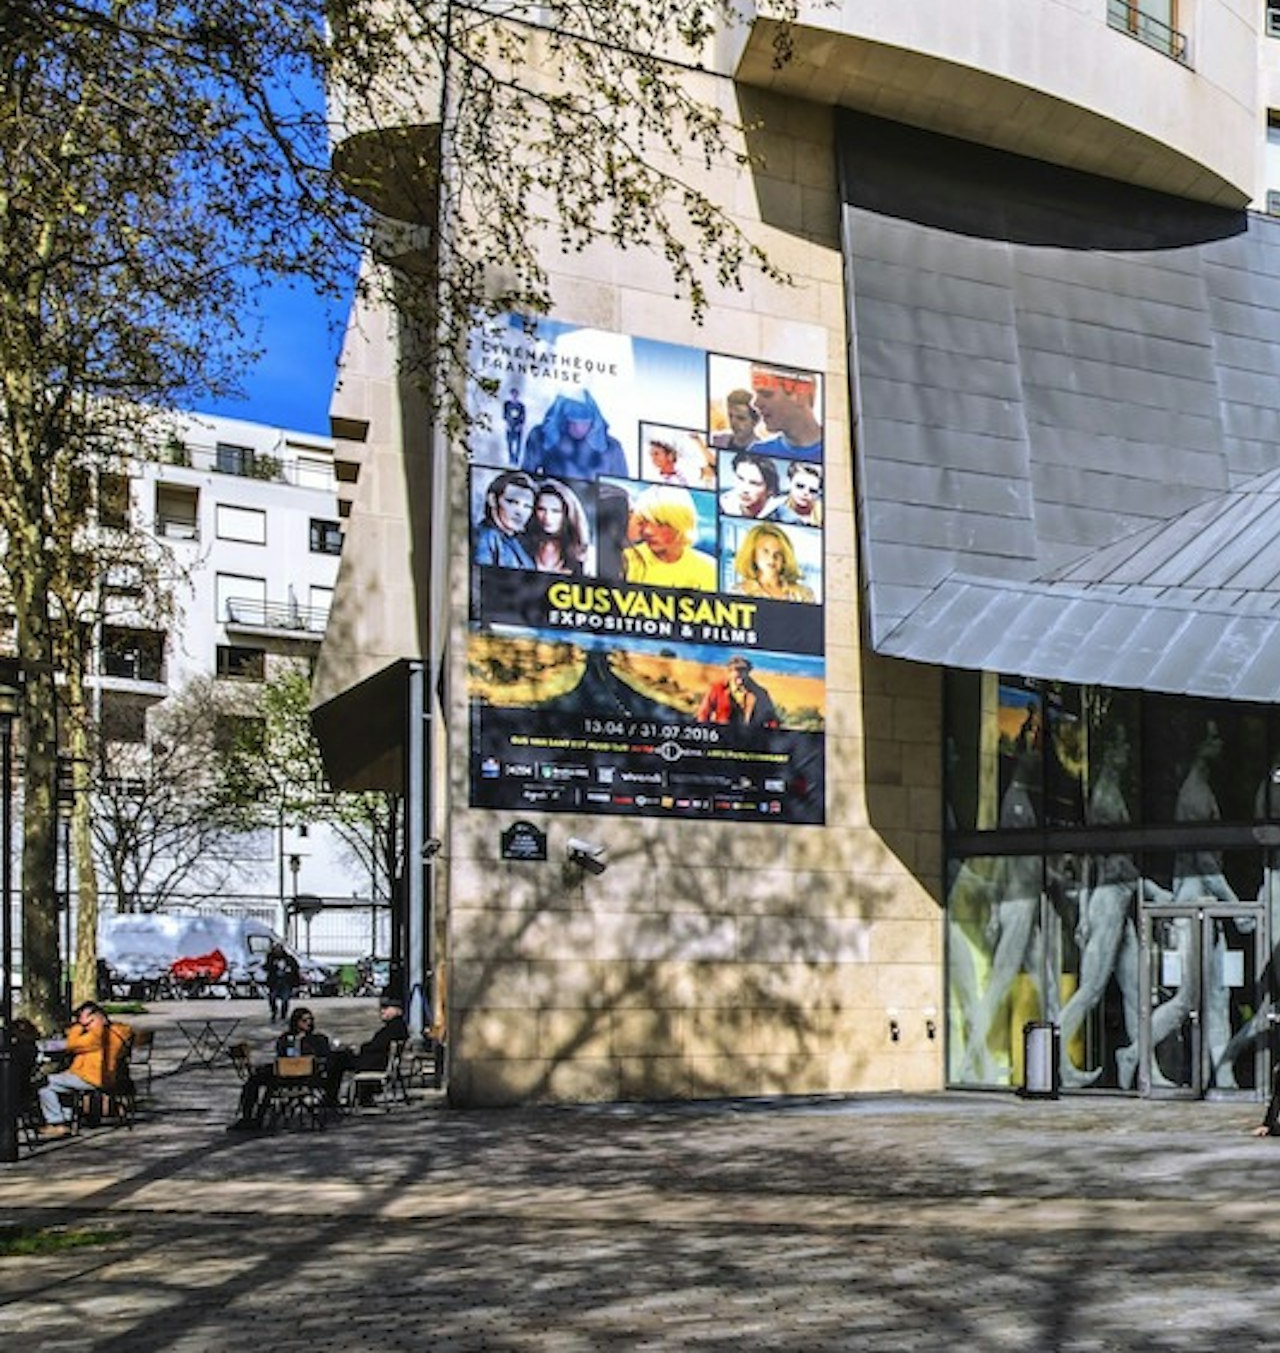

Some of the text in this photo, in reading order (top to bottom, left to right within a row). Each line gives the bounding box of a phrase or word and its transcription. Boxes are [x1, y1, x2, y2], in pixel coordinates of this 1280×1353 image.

[482, 340, 618, 375] CINÉMATHÈQUE
[482, 356, 582, 384] FRANÇAISE
[548, 582, 758, 630] GUS VAN SANT
[550, 609, 758, 645] EXPOSITION & FILMS
[584, 718, 625, 735] 13.04
[640, 722, 720, 743] 31.07.2016
